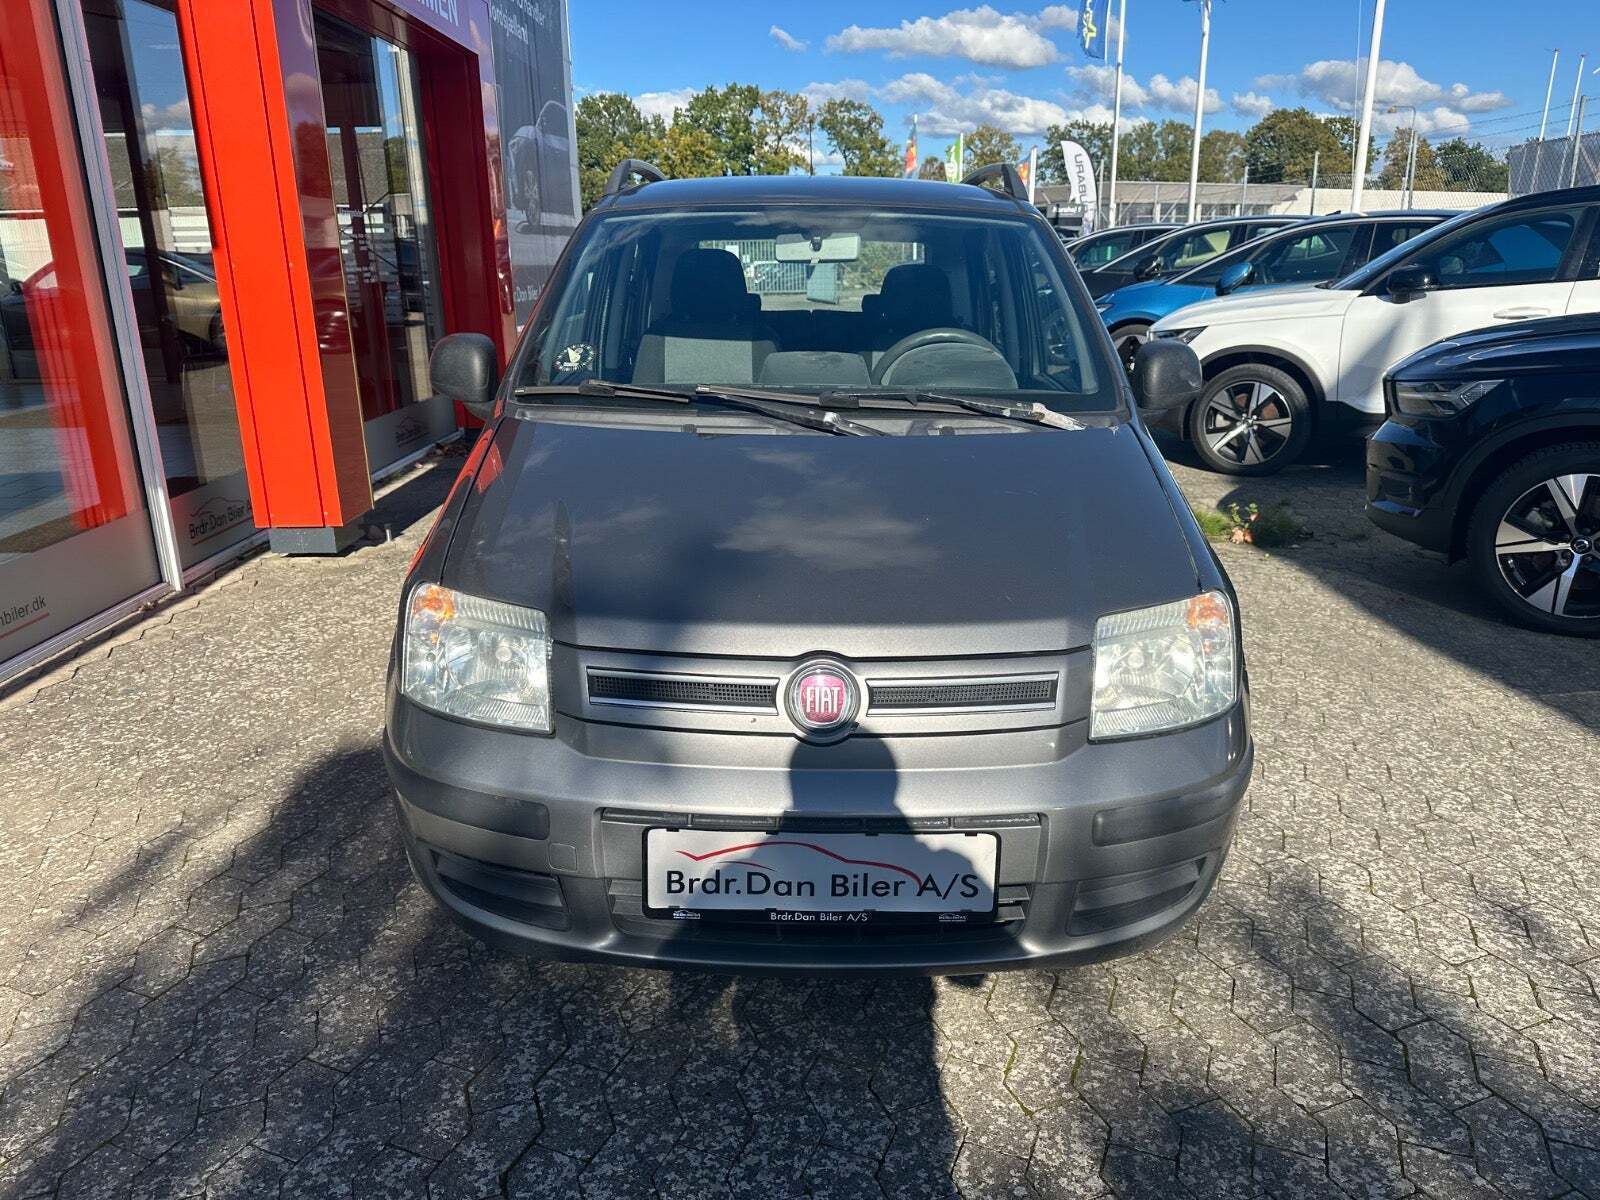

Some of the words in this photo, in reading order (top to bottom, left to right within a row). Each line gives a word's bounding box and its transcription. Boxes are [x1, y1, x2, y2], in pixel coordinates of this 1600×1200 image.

[806, 686, 841, 714] FIAT
[666, 869, 815, 897] Brdr.Dan
[831, 873, 906, 897] Biler
[916, 873, 979, 900] A/S
[770, 912, 816, 921] Brdr.Dan
[820, 912, 843, 921] Biler
[846, 912, 869, 922] A/S
